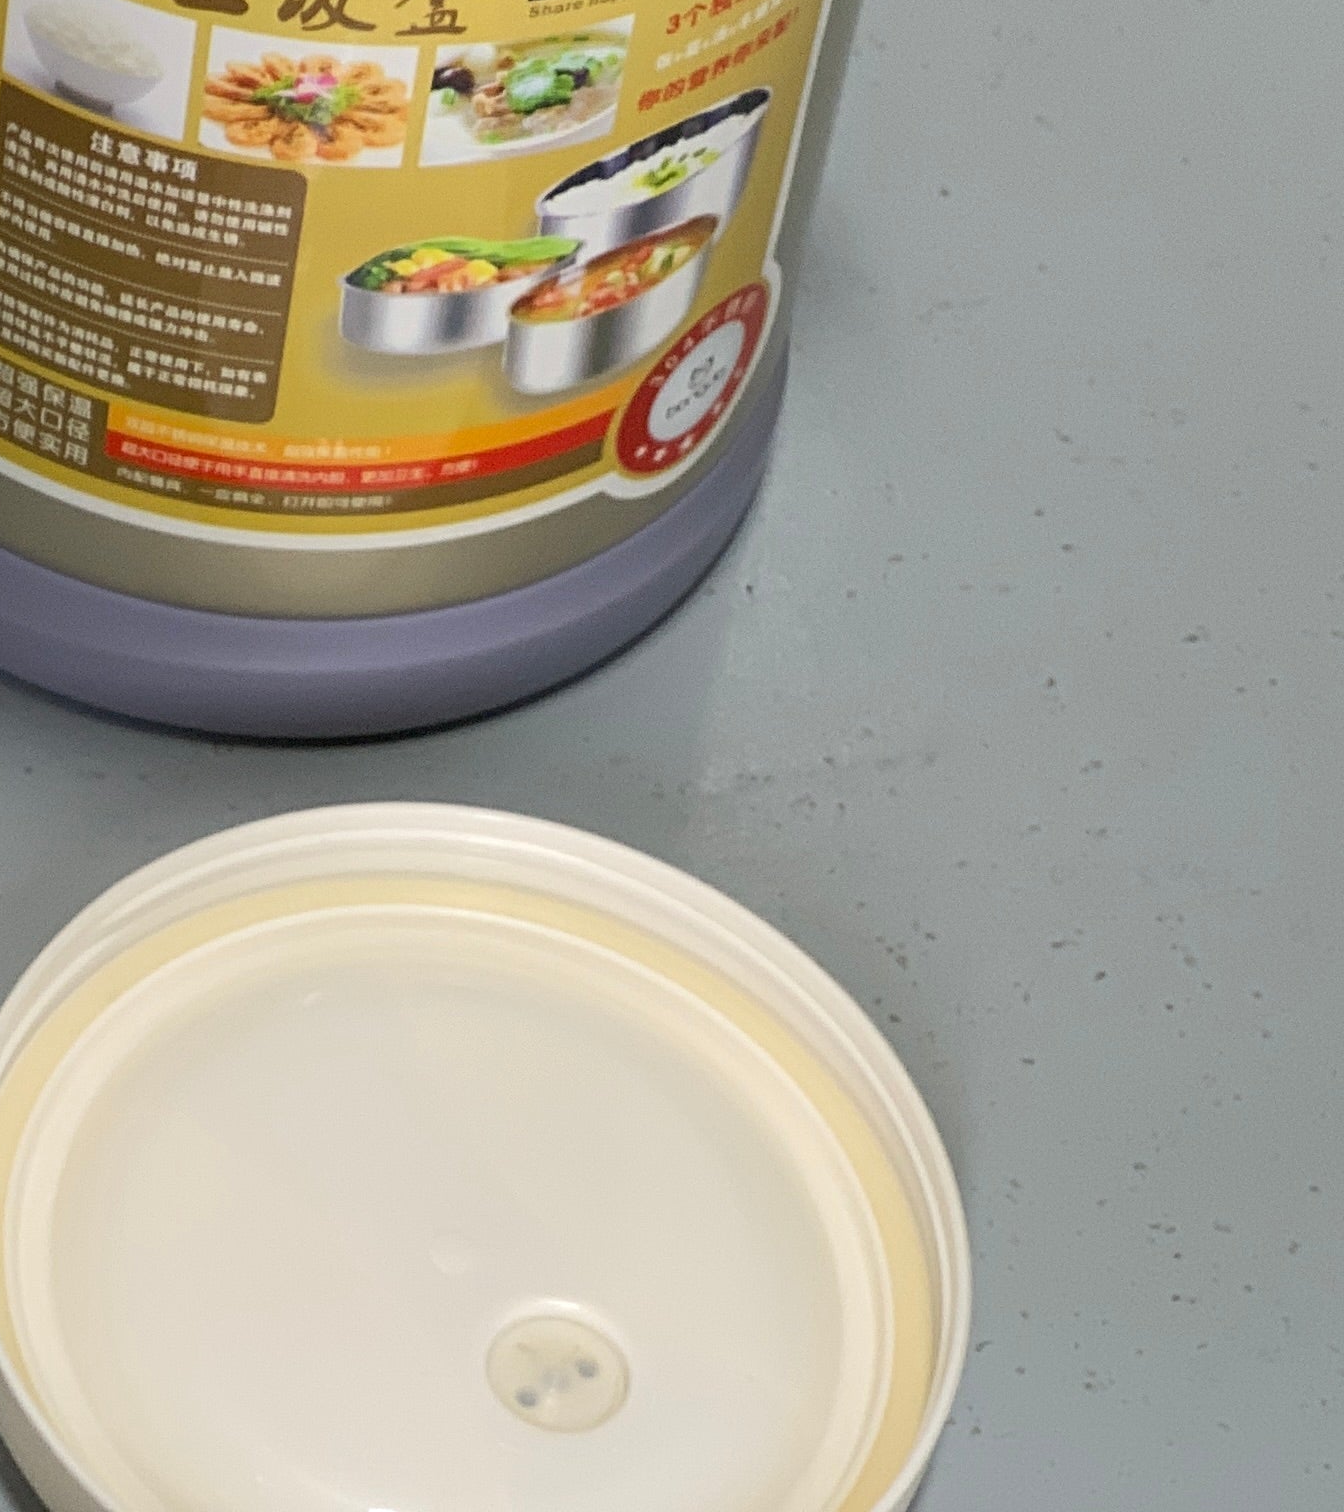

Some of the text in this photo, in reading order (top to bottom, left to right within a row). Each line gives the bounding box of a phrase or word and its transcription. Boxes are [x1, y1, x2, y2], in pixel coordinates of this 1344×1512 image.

[529, 0, 584, 18] Share
[90, 130, 199, 182] 注意事项
